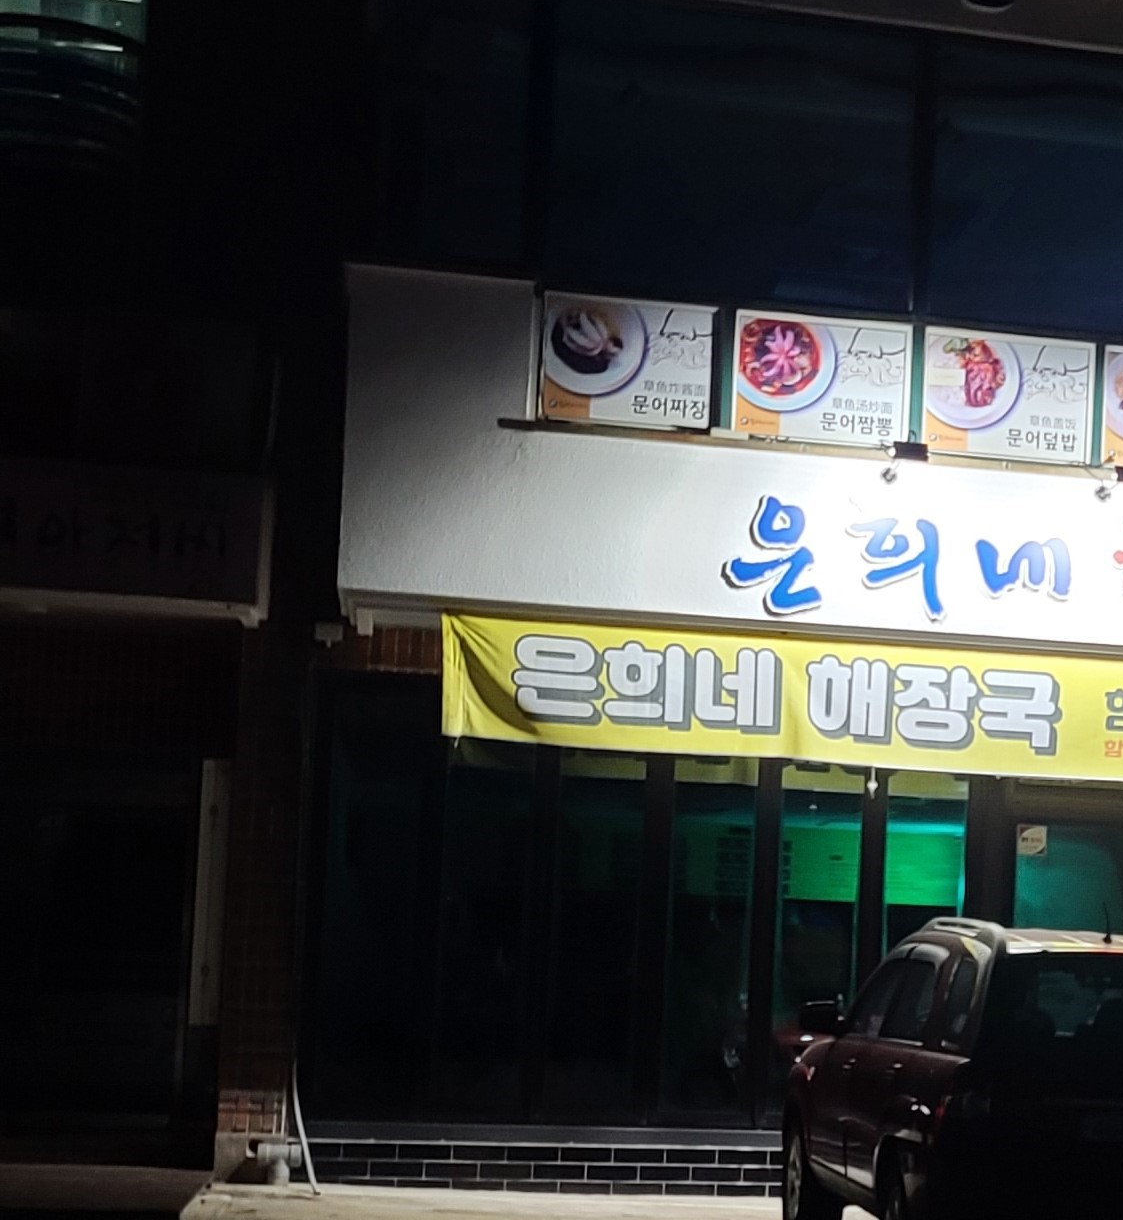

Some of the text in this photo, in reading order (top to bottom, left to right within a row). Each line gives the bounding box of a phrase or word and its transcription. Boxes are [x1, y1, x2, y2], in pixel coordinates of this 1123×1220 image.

[631, 395, 707, 420] 문어짜장
[819, 412, 894, 437] 문어짬뽕
[1005, 428, 1078, 453] 문어덮밥
[722, 493, 1072, 622] 은희네
[511, 634, 1064, 756] 은희네 해장국
